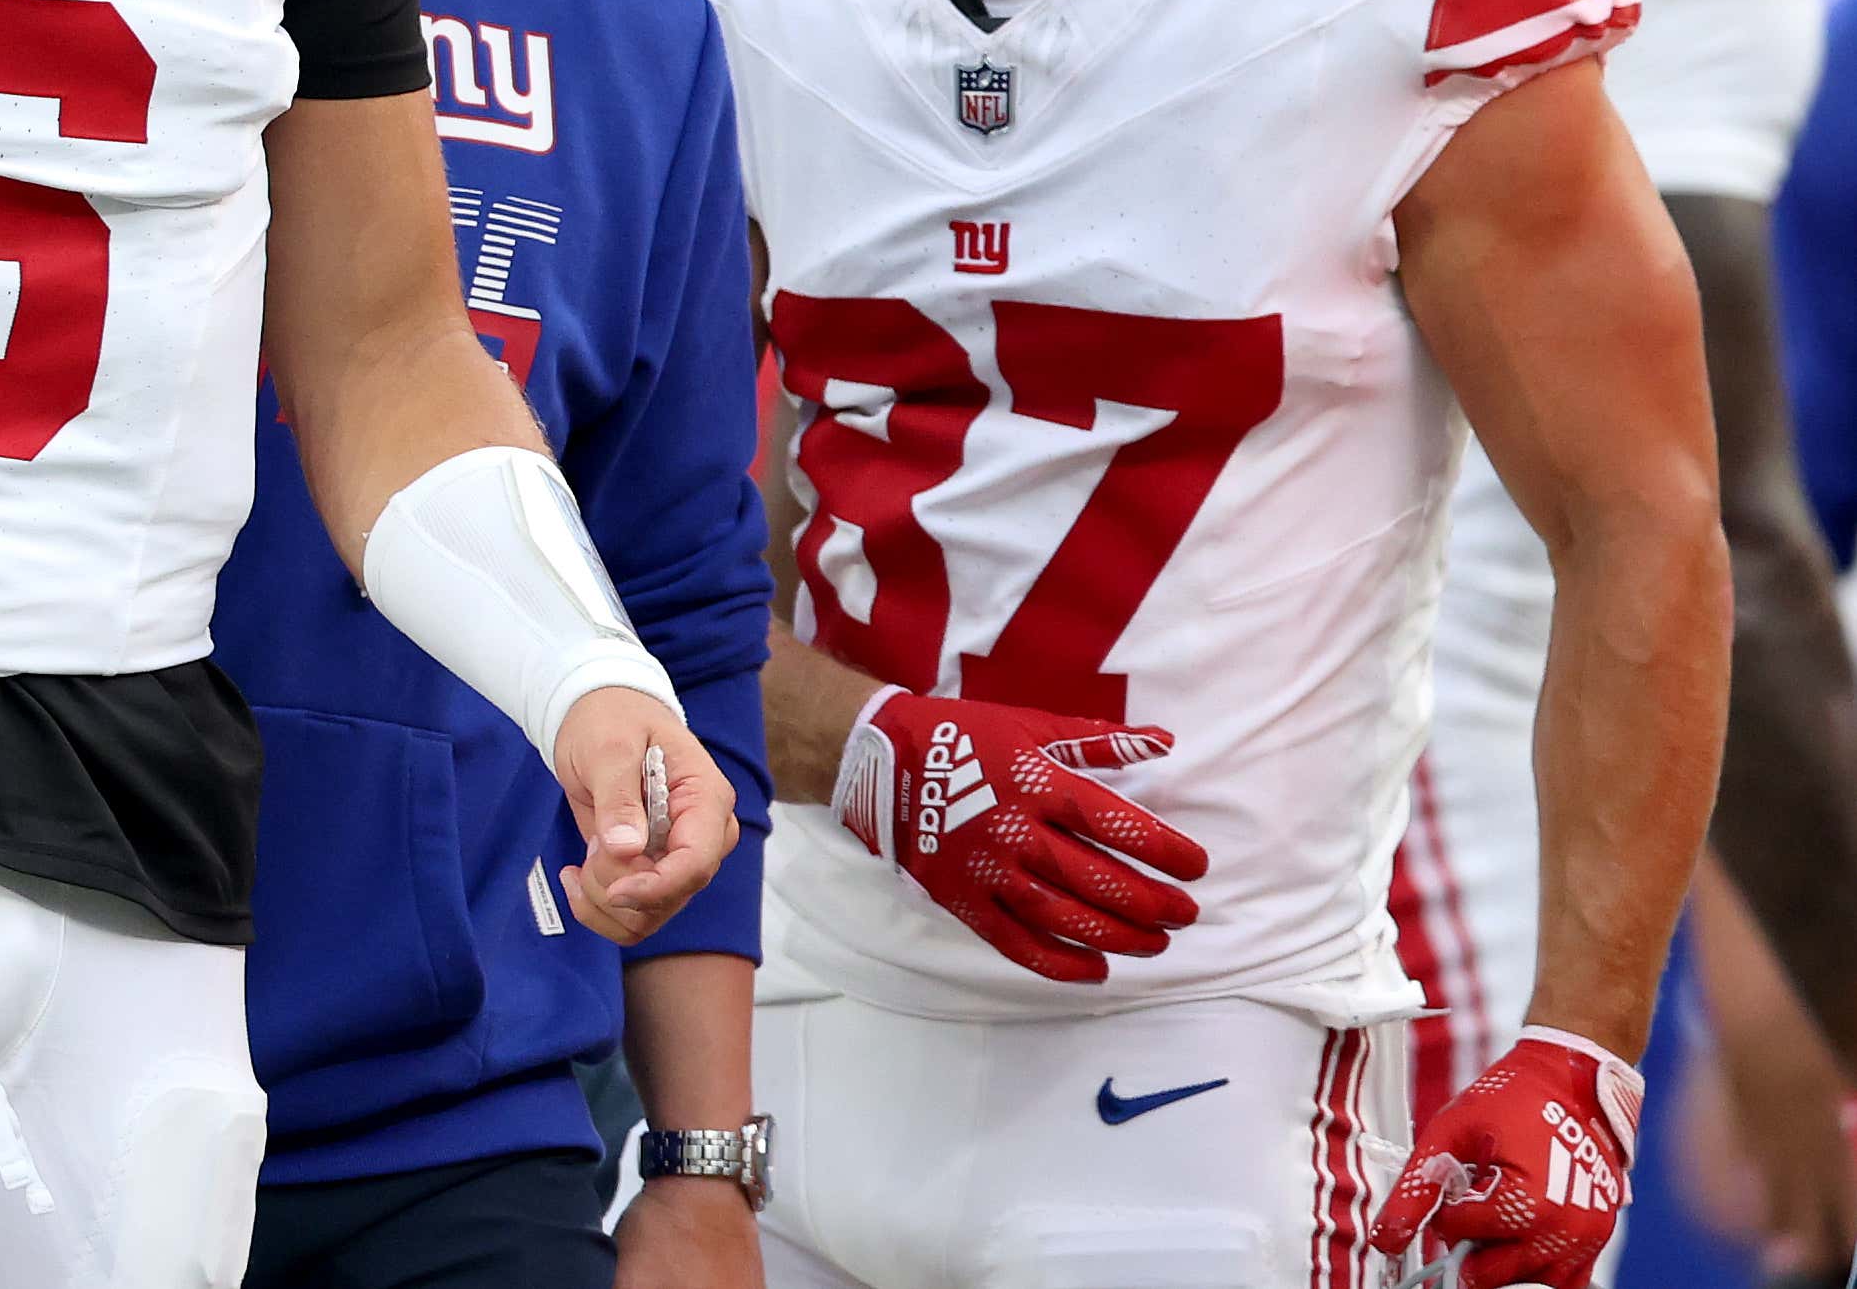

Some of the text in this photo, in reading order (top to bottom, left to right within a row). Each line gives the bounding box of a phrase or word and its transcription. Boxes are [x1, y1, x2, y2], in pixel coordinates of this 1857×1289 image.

[964, 94, 1007, 127] NFL
[771, 288, 1285, 724] 87
[917, 721, 958, 854] adidas
[1542, 1100, 1619, 1205] adidas
